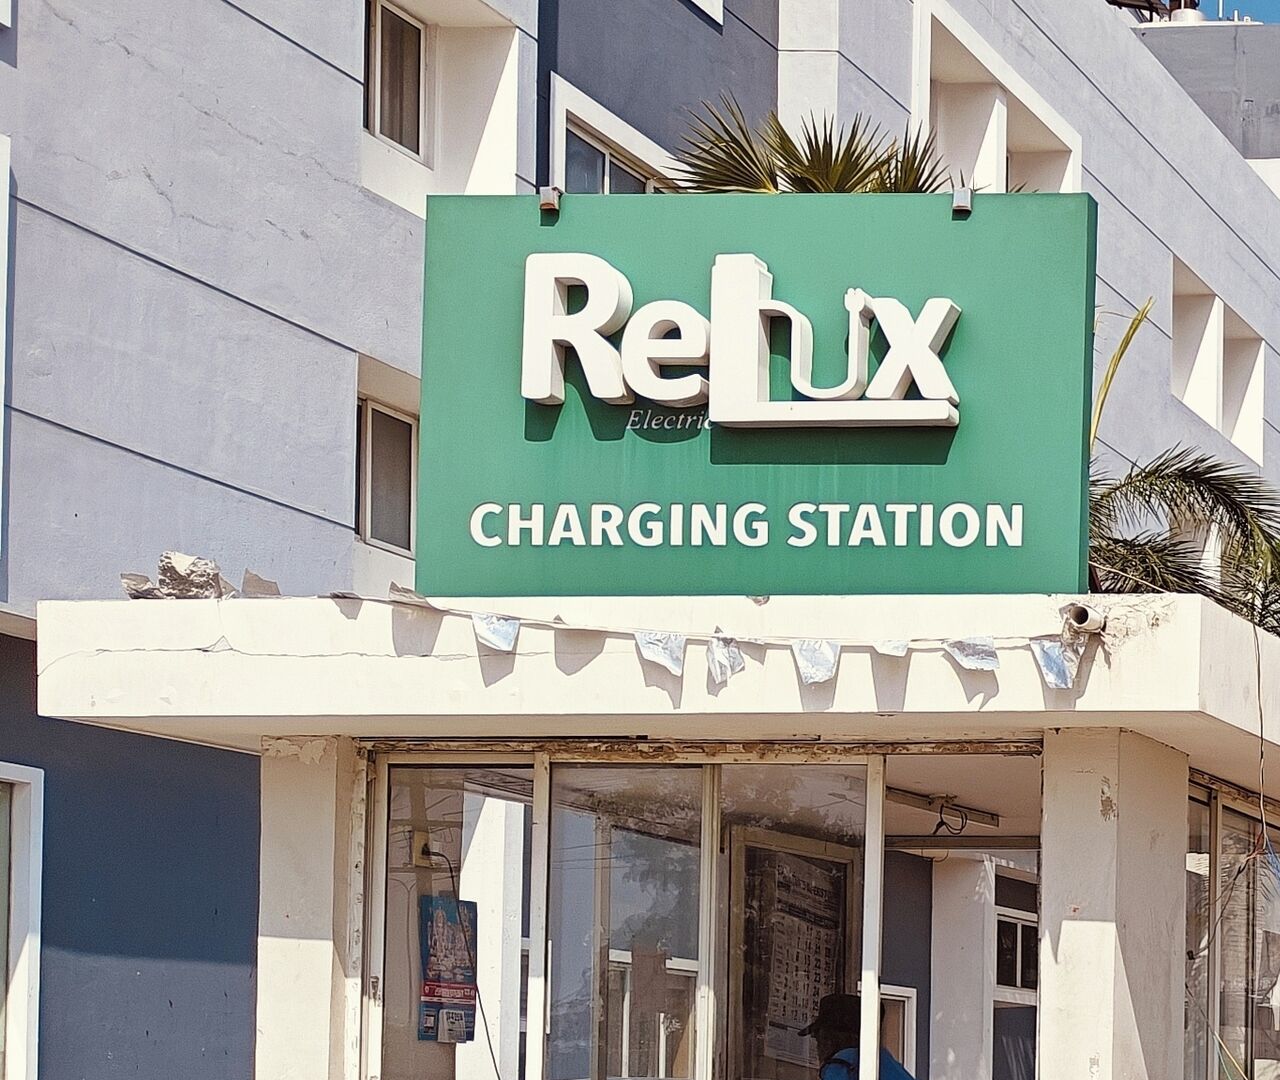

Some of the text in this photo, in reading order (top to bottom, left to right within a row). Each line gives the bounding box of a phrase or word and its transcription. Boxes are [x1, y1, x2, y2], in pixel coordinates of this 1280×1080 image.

[626, 409, 712, 430] Electric
[469, 502, 1024, 548] CHARGING STATION
